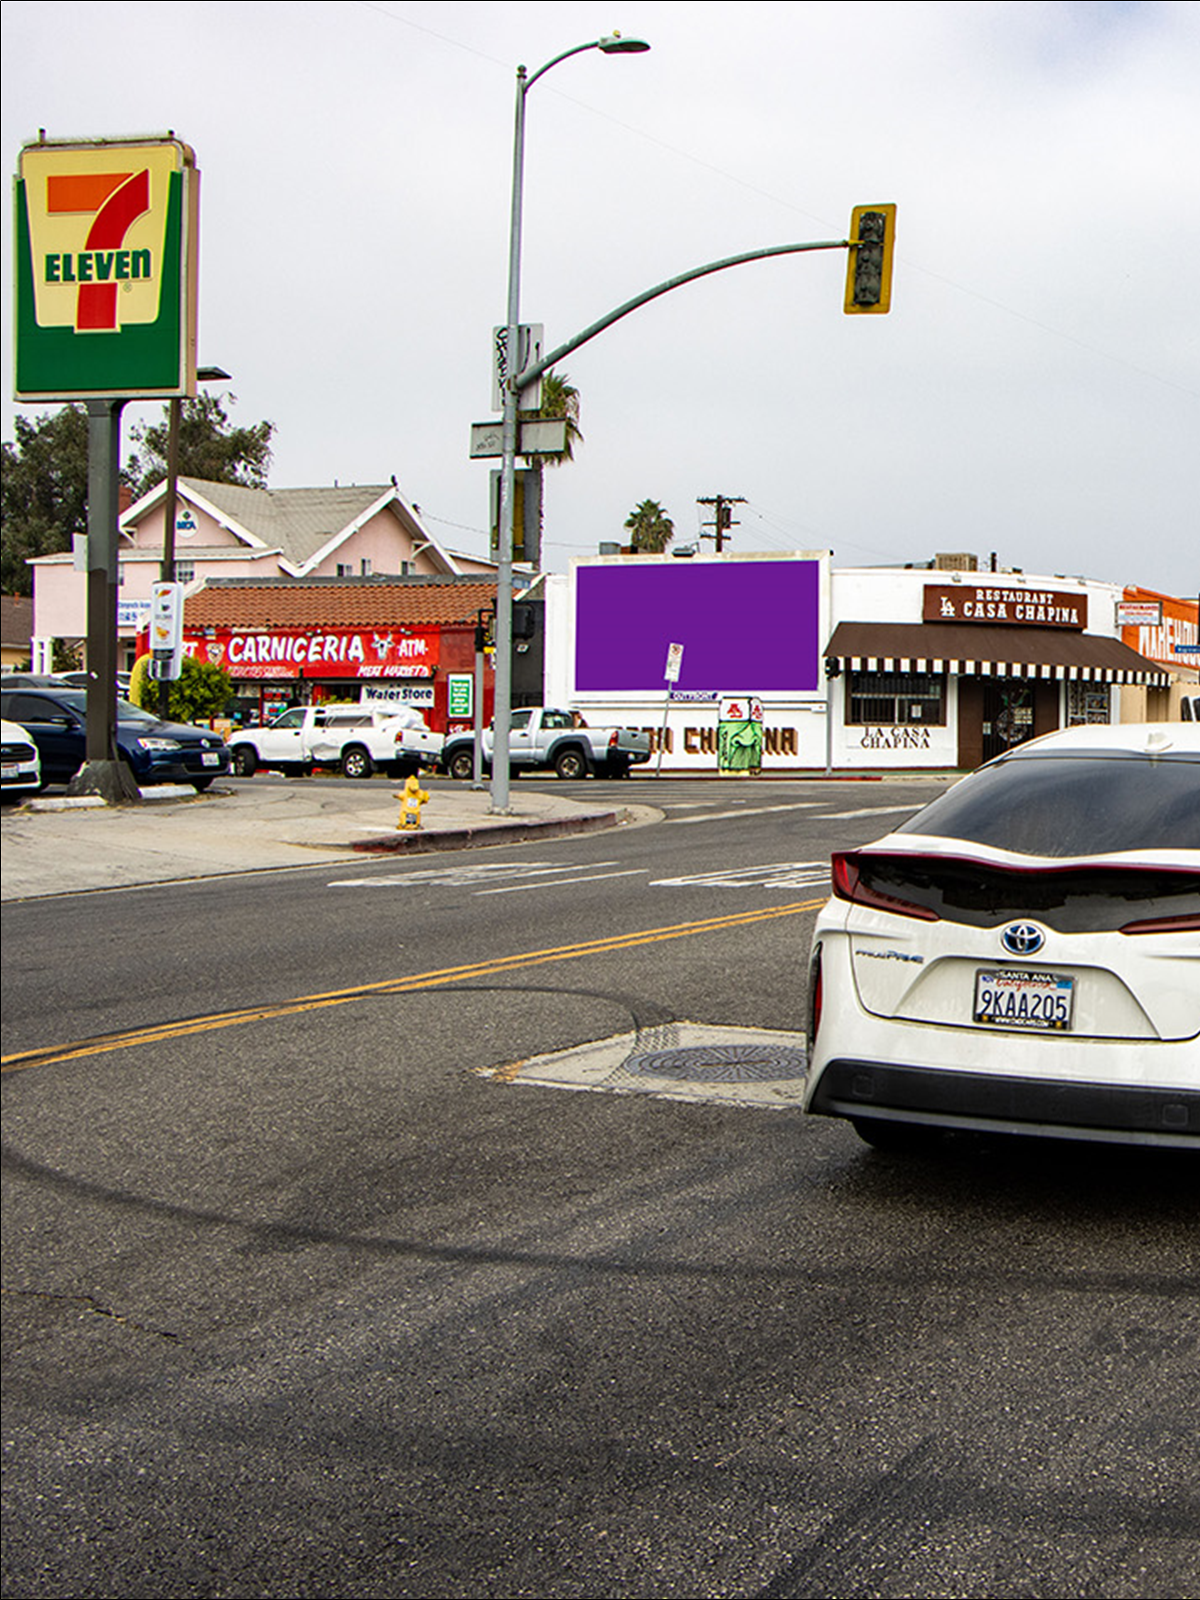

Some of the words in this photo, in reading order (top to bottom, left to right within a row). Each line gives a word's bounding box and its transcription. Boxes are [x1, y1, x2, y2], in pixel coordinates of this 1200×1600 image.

[46, 168, 150, 330] 7
[976, 589, 1054, 605] RESTAURANT
[940, 596, 955, 617] LA
[963, 601, 1008, 620] CASA
[1015, 605, 1079, 624] CHAPINA
[228, 634, 365, 663] CARNICERIA
[357, 665, 383, 677] MEAT
[365, 687, 400, 700] Water
[402, 687, 433, 700] Store
[864, 727, 884, 738] LA
[890, 727, 931, 738] CASA
[683, 727, 799, 756] CHNA
[860, 737, 931, 749] CHAPINA
[1000, 970, 1029, 980] SANTA
[1031, 973, 1052, 982] ANA
[980, 989, 1068, 1021] 9KAA205
